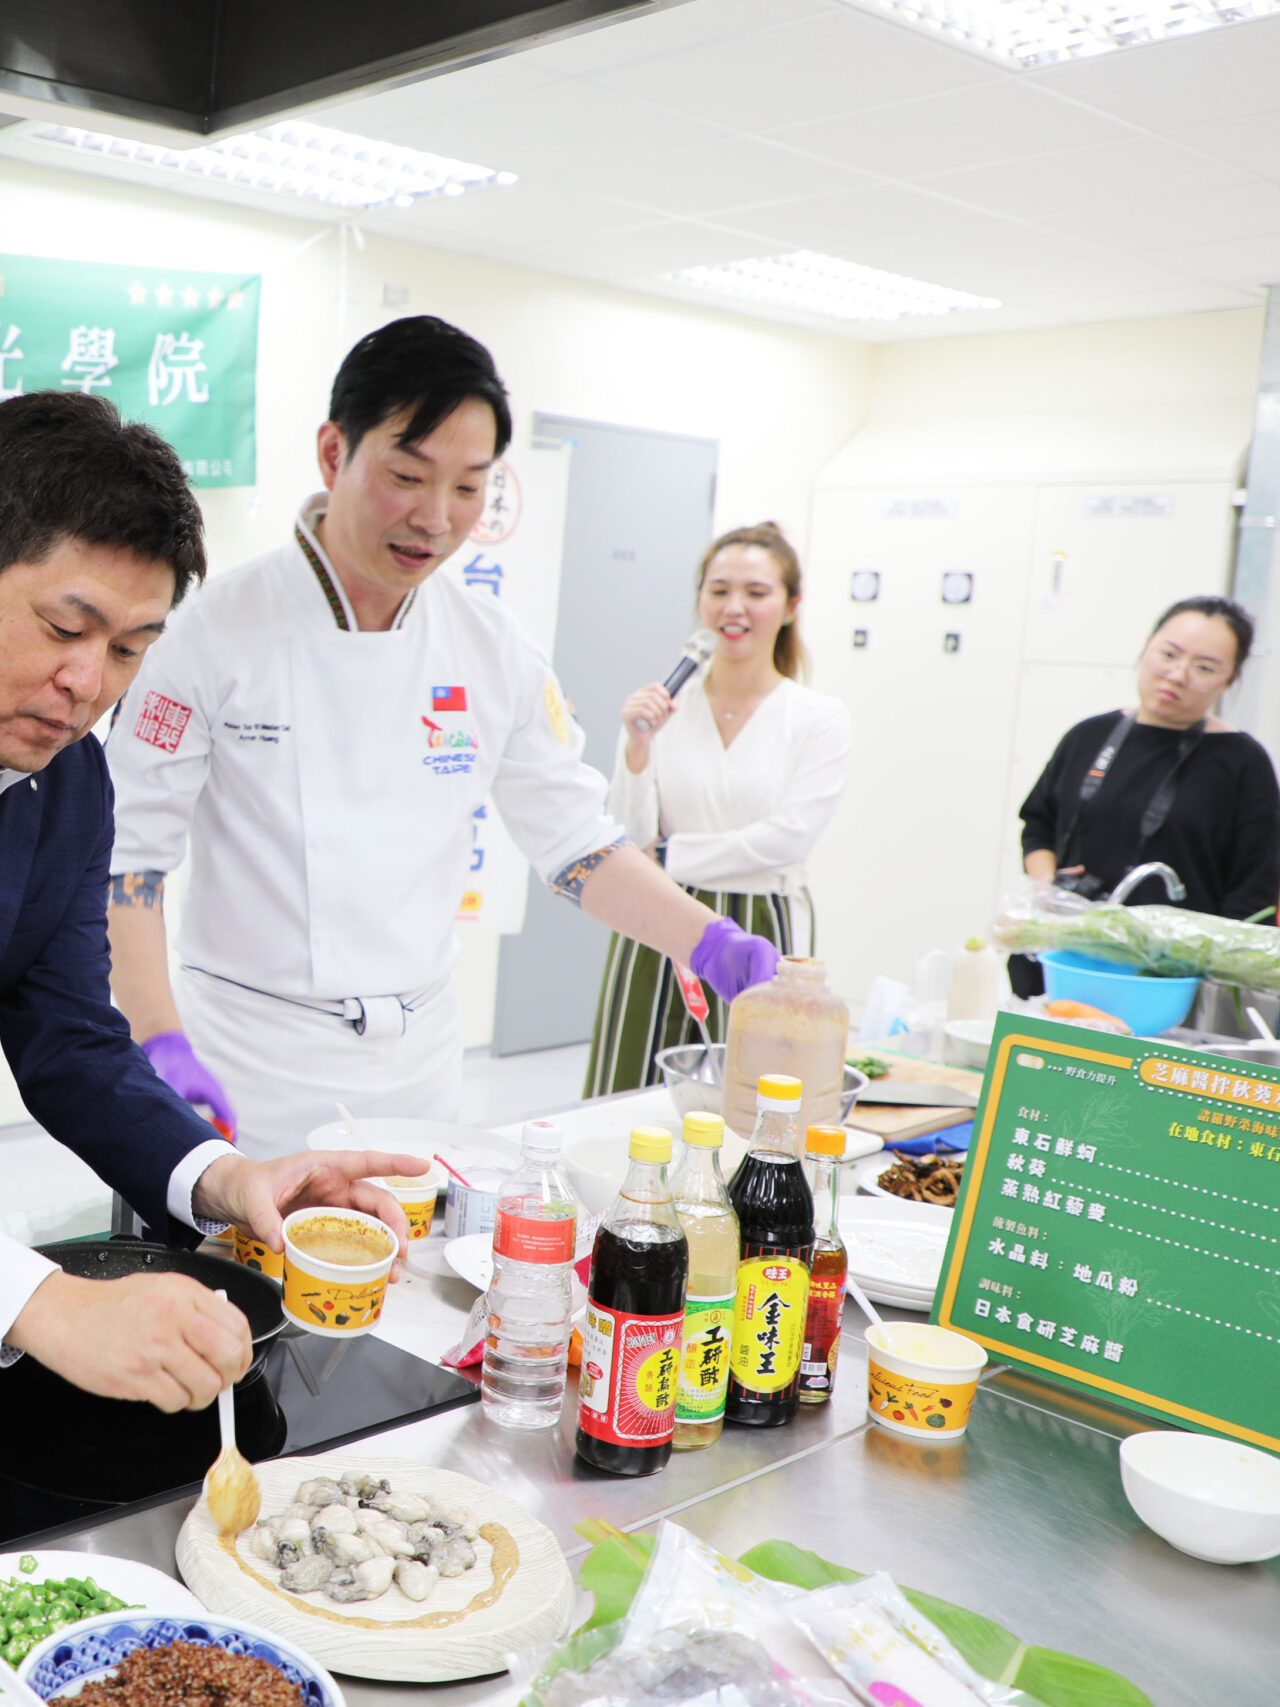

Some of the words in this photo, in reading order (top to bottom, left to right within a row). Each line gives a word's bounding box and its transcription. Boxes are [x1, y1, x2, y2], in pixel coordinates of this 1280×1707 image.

[1065, 1065, 1117, 1087] 野食力提升
[1012, 1127, 1098, 1164] 東石鮮蚵
[1006, 1152, 1047, 1178] 秋葵
[1000, 1177, 1107, 1223] 蒸熟紅藜麥
[765, 1266, 788, 1280] 味王
[756, 1292, 791, 1375] 金味王
[974, 1298, 1124, 1363] 日本食研芝麻醬
[870, 1371, 903, 1392] elicious
